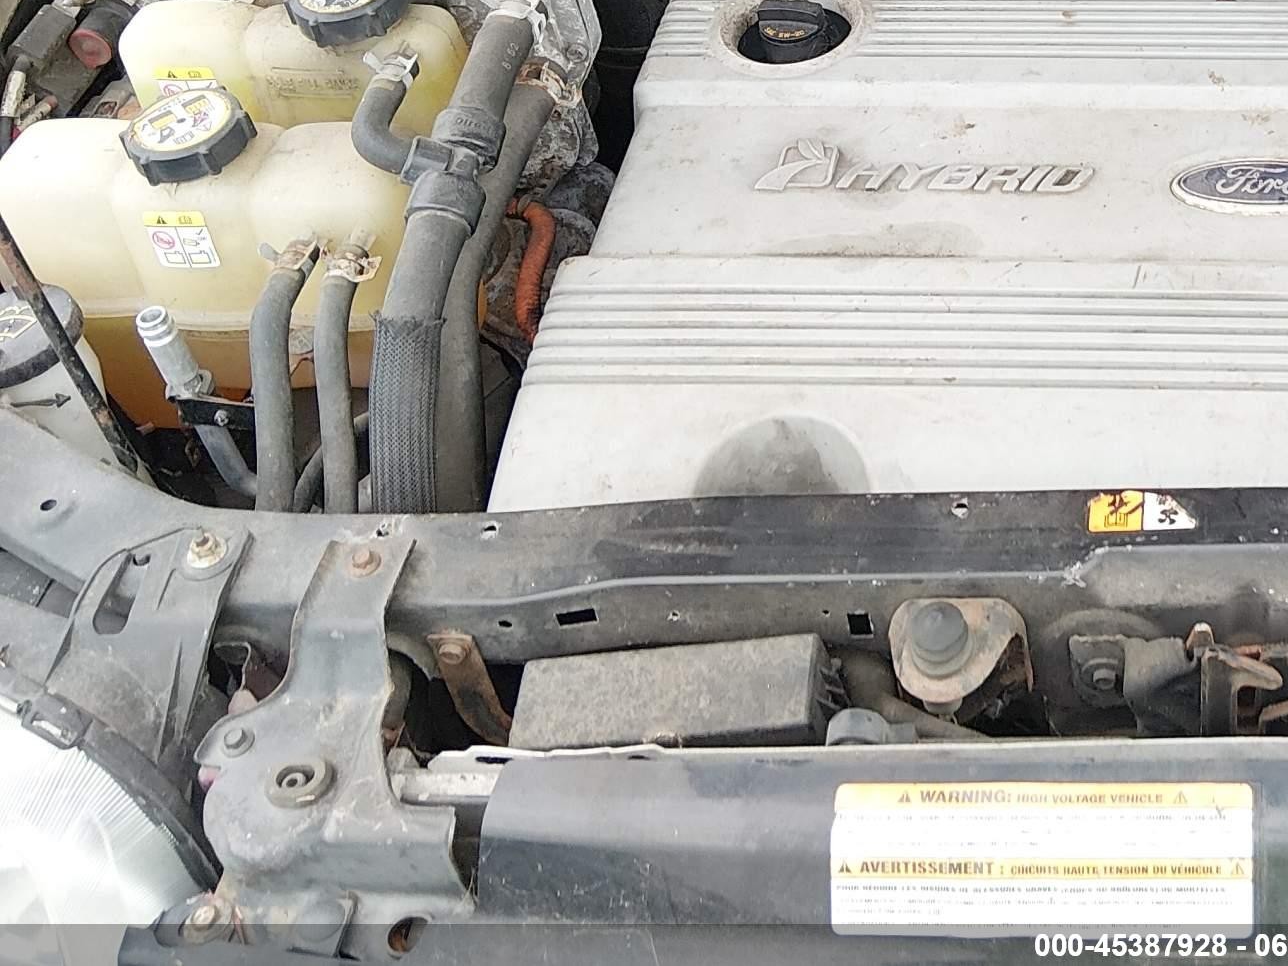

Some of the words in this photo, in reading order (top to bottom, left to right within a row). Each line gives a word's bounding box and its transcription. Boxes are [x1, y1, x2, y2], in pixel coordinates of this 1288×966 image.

[836, 162, 1095, 192] HYBRID
[920, 790, 1012, 803] WARNING:
[1017, 794, 1048, 804] HIGH
[1052, 794, 1106, 804] VOLTAGE
[1110, 794, 1163, 804] VEHICLE
[860, 861, 994, 875] AVERTISSEMENT
[1010, 866, 1059, 875] CIRCUITS
[1064, 866, 1098, 875] HAUTE
[1104, 866, 1148, 875] TENSION
[1152, 866, 1166, 874] DU
